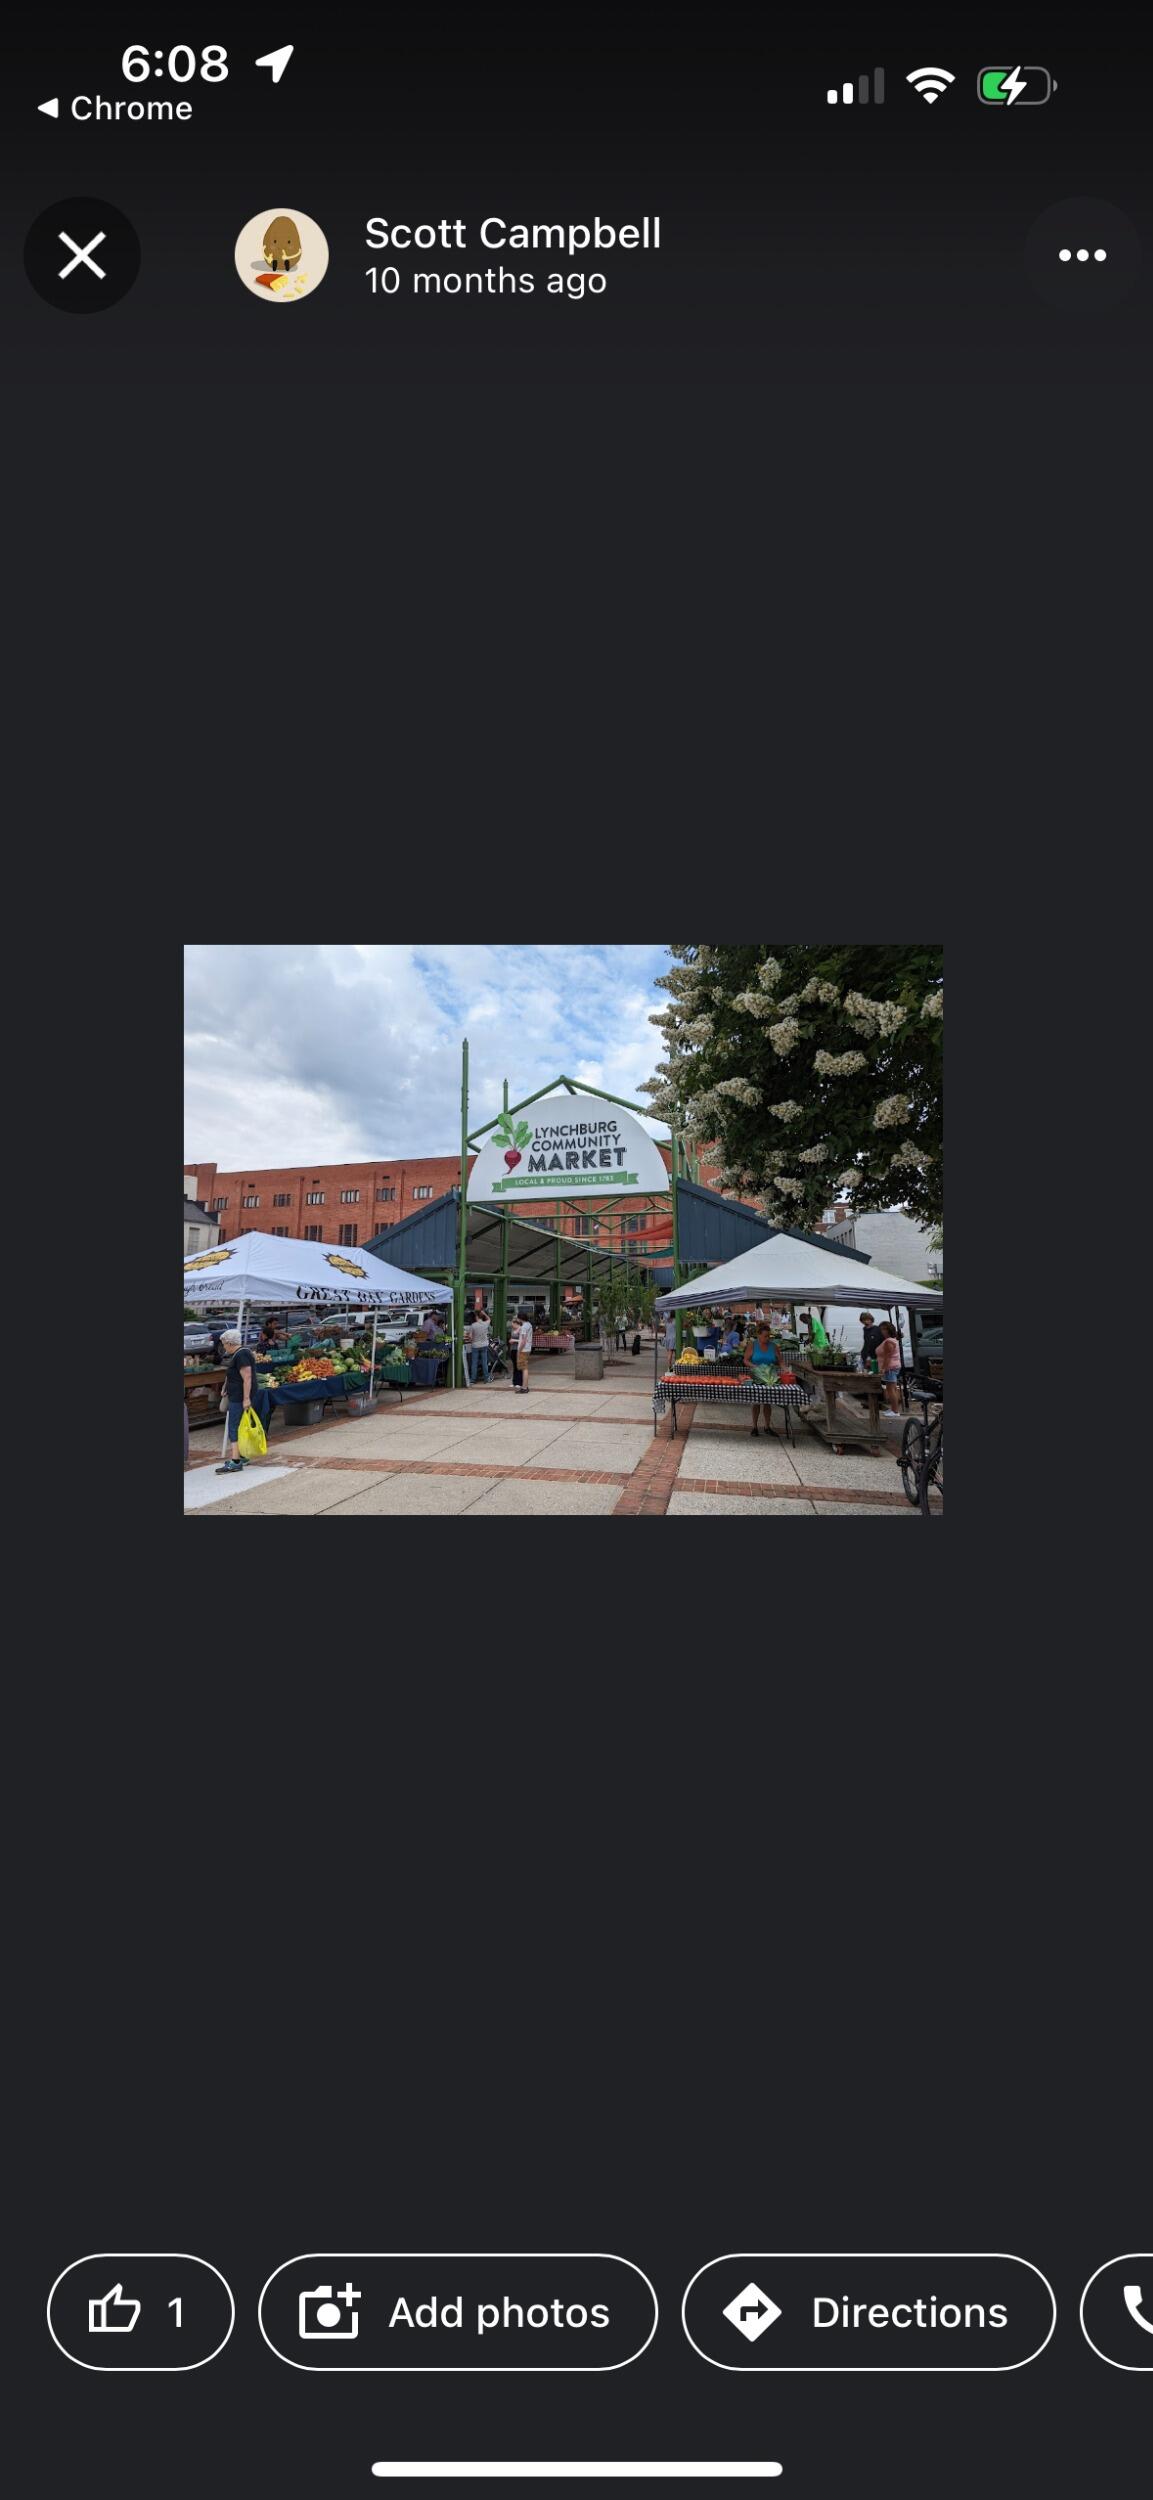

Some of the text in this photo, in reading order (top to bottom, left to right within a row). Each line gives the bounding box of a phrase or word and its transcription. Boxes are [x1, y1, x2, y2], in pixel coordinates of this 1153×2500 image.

[535, 1120, 617, 1139] LYNCHBURG
[531, 1133, 621, 1152] COMMUNITY
[527, 1146, 627, 1173] MARKET
[515, 1178, 538, 1186] LOCAL
[546, 1176, 573, 1185] PROUD
[574, 1175, 597, 1184] SINCE
[296, 1285, 350, 1302] GREAT
[389, 1290, 436, 1304] GARDENS
